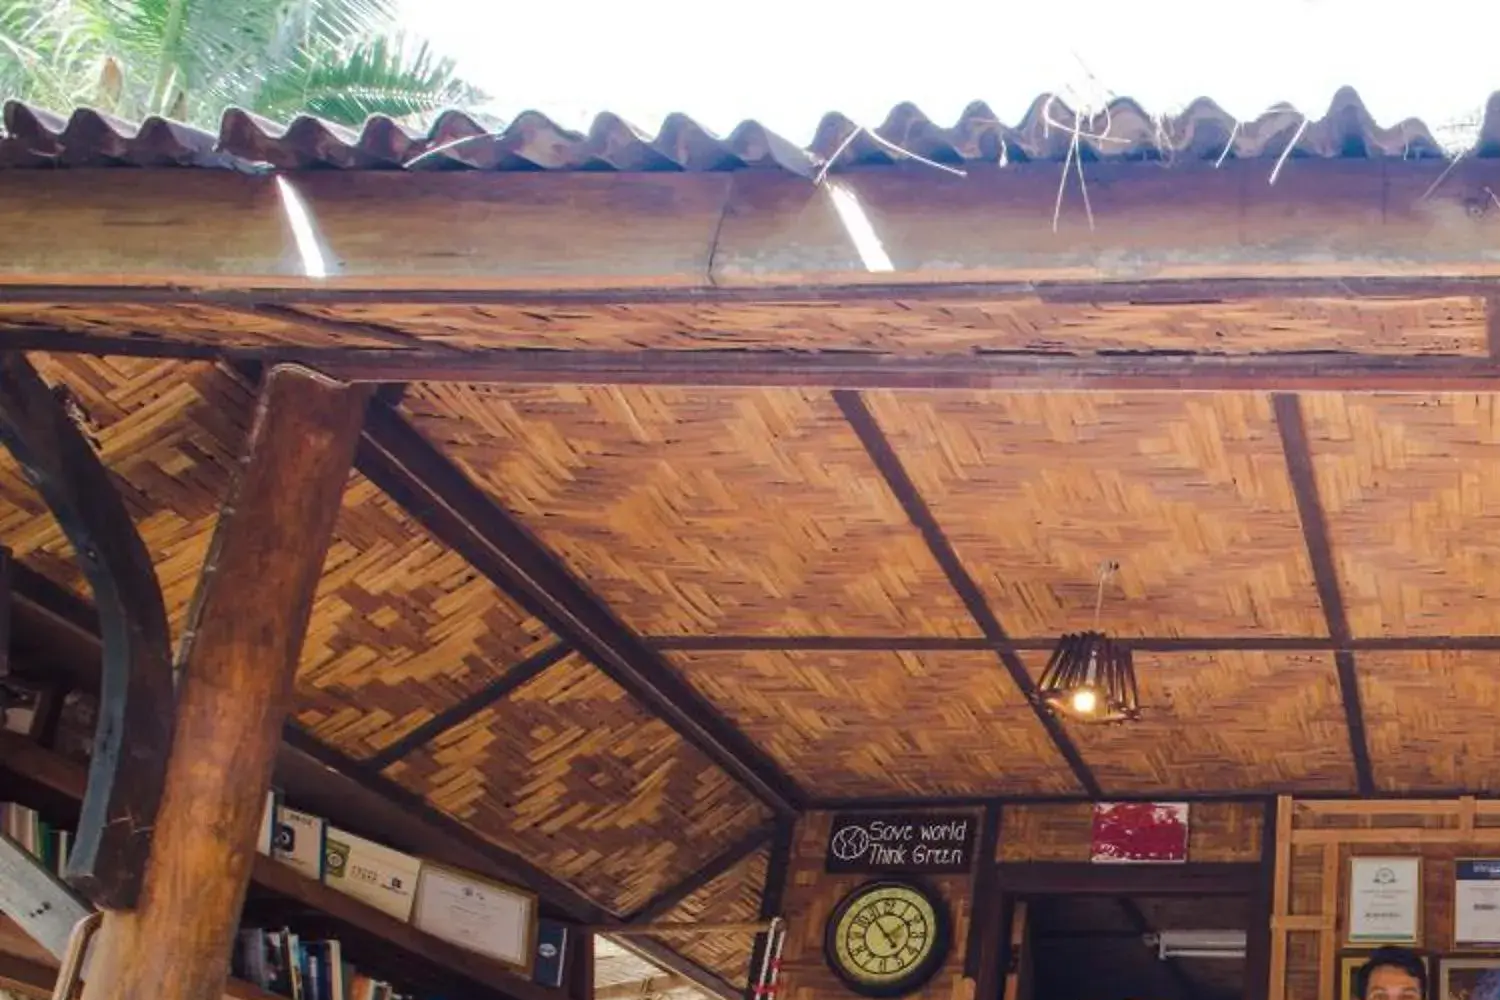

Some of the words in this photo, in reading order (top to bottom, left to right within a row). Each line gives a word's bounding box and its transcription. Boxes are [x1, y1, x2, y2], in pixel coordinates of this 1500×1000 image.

[869, 821, 913, 841] Save
[921, 820, 967, 842] world
[868, 843, 907, 865] Think
[912, 844, 963, 865] Green
